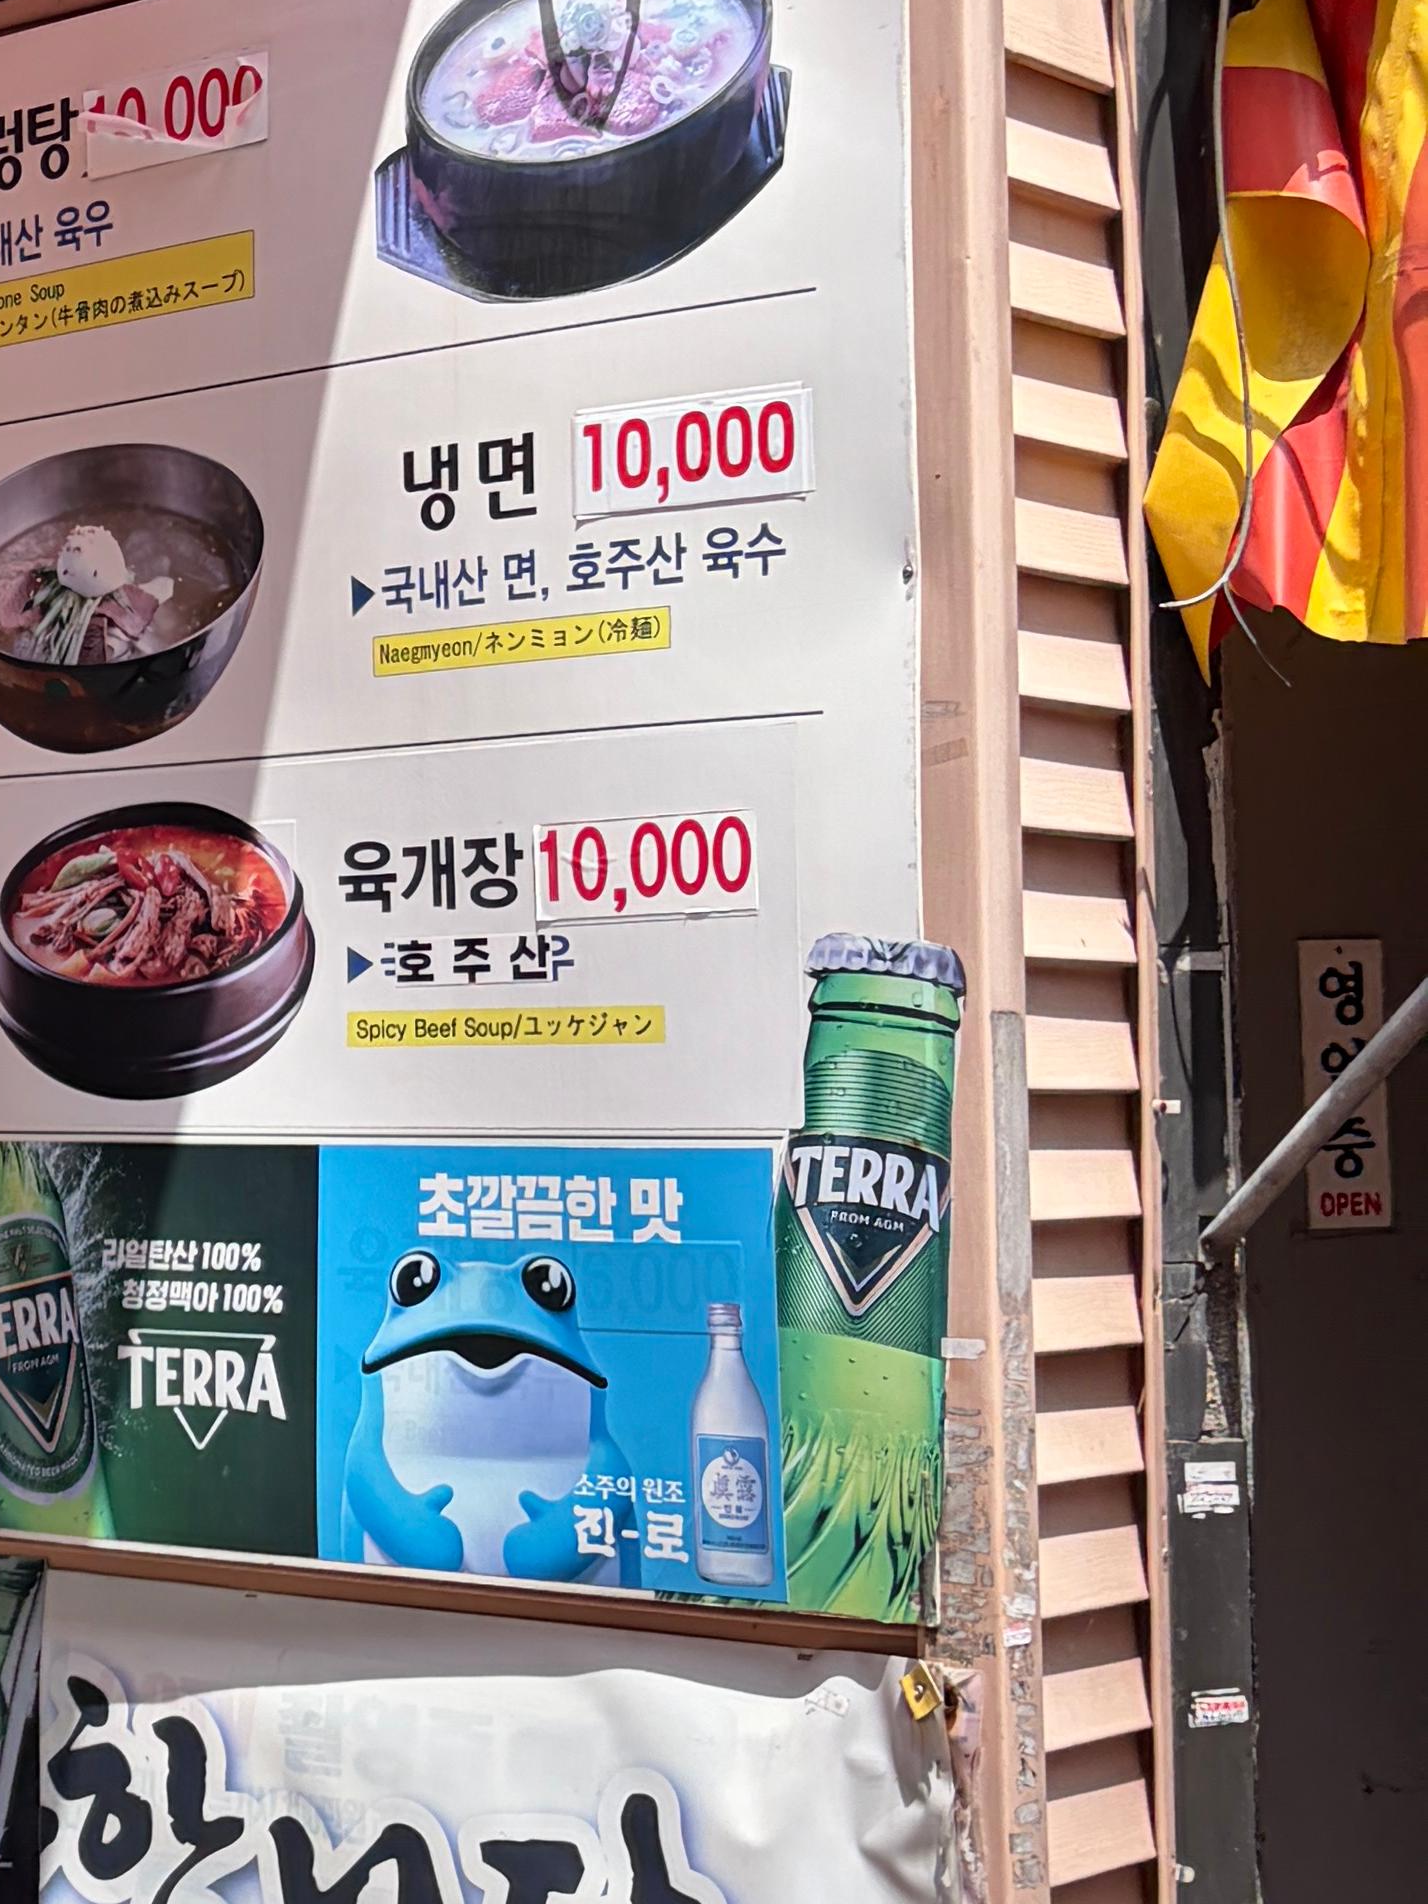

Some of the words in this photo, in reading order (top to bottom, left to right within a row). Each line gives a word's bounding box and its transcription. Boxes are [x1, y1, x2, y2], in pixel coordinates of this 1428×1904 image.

[53, 199, 114, 252] 육우
[29, 281, 66, 303] Soup
[403, 431, 538, 532] 냉면
[581, 399, 796, 505] 10,000
[380, 554, 488, 616] 국내산
[503, 548, 550, 603] 면,
[565, 531, 688, 594] 호주산
[701, 521, 788, 580] 육수
[337, 831, 524, 914] 육개장
[538, 815, 752, 913] 10,000
[355, 1017, 407, 1044] Spicy
[413, 1017, 458, 1040] Beef
[416, 1171, 617, 1243] 초깔끔한
[629, 1177, 684, 1245] 맛
[791, 1145, 940, 1233] TERRA
[1320, 1192, 1383, 1218] OPEN
[829, 1209, 871, 1226] FROM
[872, 1216, 905, 1233] AGM
[101, 1238, 198, 1272] 리얼탄산
[201, 1242, 262, 1271] 100%
[122, 1279, 220, 1315] 청정맥아
[223, 1283, 284, 1315] 100%
[116, 1344, 288, 1421] TERRA
[573, 1473, 637, 1503] 소주의
[642, 1477, 686, 1504] 원조
